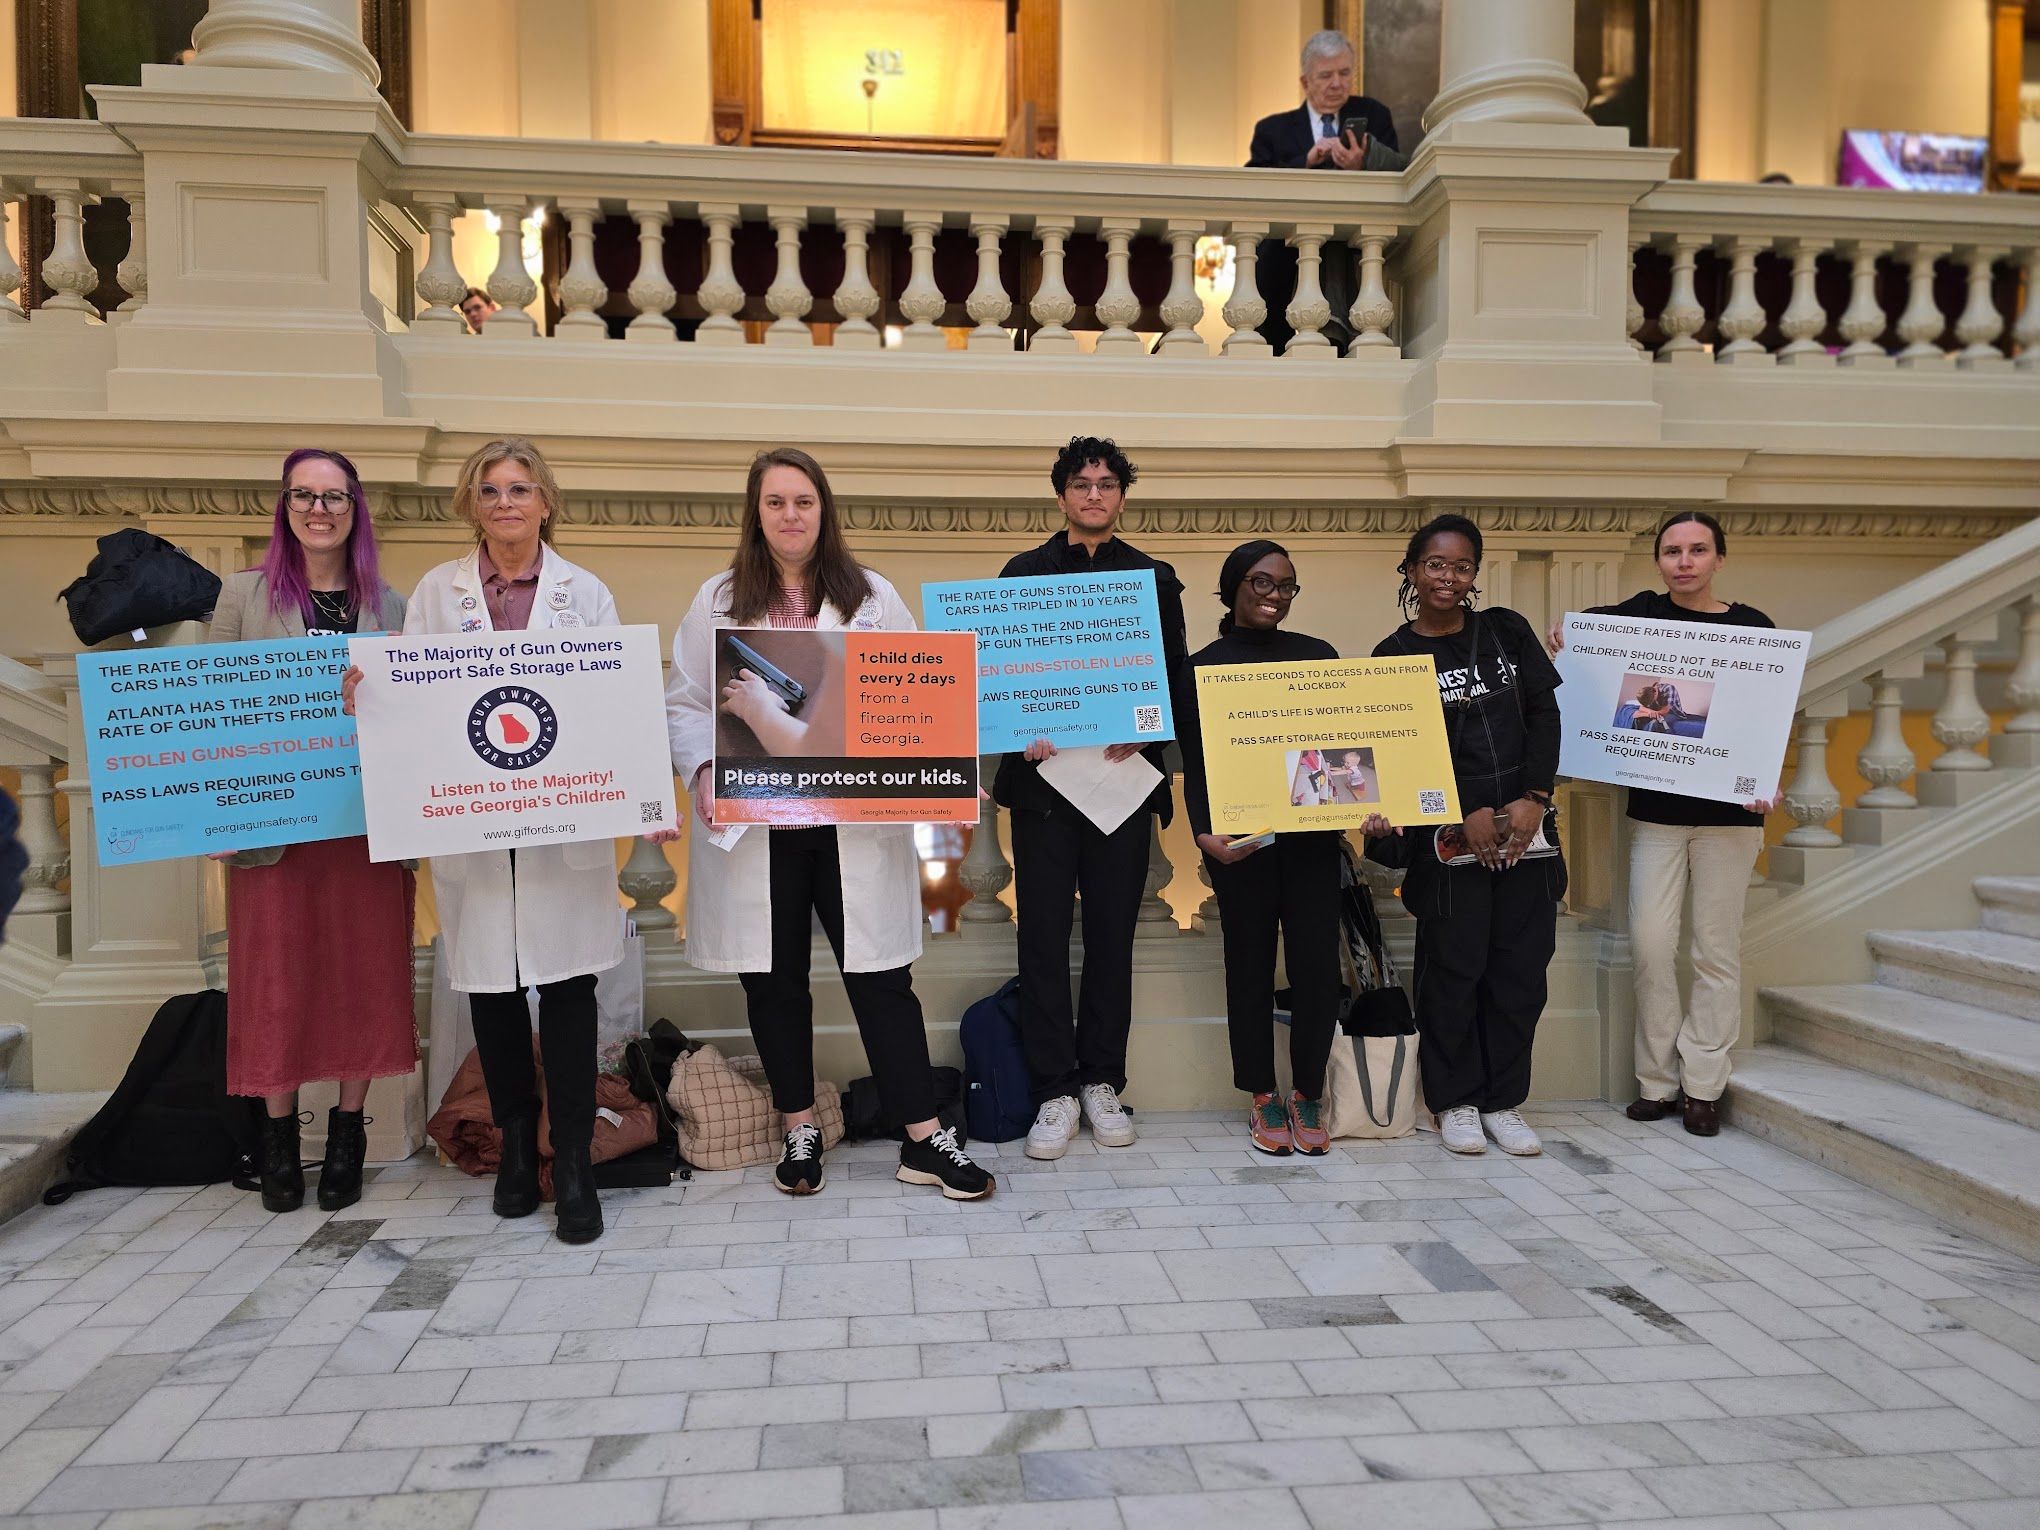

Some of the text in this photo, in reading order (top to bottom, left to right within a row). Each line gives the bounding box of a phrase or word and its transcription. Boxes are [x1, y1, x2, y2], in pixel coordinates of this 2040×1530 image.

[936, 582, 1142, 604] THE RATE OF GUNS STOLEN FROM
[945, 596, 1138, 616] CARS HAS TRIPLED IN 10 YEARS
[1002, 623, 1028, 634] HAS
[1032, 622, 1056, 633] THE
[1060, 620, 1084, 631] 2ND
[1088, 616, 1142, 629] HIGHEST
[994, 638, 1022, 649] GUN
[1025, 635, 1073, 648] THEFTS
[1076, 632, 1112, 644] FROM
[1116, 630, 1150, 641] CARS
[1571, 621, 1802, 650] GUN SUICIDE RATES IN KIDS ARE RISING
[386, 640, 623, 663] The Majority of Gun Owners
[860, 652, 943, 664] 1 child dies
[1572, 644, 1784, 674] CHILDREN SHOULD NOT BE ABLE TO
[99, 648, 350, 678] THE RATE OF GUNS STOLEN FR
[391, 658, 622, 684] Support Safe Storage Laws
[1004, 657, 1110, 675] GUNS=STOLEN
[1114, 654, 1154, 667] LIVES
[1628, 662, 1715, 680] ACCESS A GUN
[111, 664, 346, 693] CARS HAS TRIPLED IN 10 YEA
[860, 673, 956, 687] every 2 days
[1203, 674, 1213, 684] IT
[1214, 673, 1246, 683] TAKES
[1256, 670, 1305, 680] SECONDS
[1306, 670, 1322, 678] TO
[1323, 667, 1362, 678] ACCESS
[1364, 667, 1372, 676] A
[1374, 666, 1397, 676] GUN
[1398, 664, 1428, 674] FROM
[978, 680, 1158, 703] AWS REQUIRING GUNS TO BE
[1288, 680, 1346, 692] A LOCKBOX
[107, 690, 342, 722] ATLANTA HAS THE 2ND HIGH
[472, 690, 552, 726] GUN OWNERS
[860, 692, 909, 704] from a
[1021, 700, 1080, 714] SECURED
[860, 712, 934, 724] firearm in
[1228, 712, 1236, 720] A
[1280, 708, 1302, 718] LIFE
[1304, 707, 1314, 716] IS
[1315, 704, 1354, 716] WORTH
[1355, 706, 1362, 714] 2
[1363, 703, 1413, 714] SECONDS
[99, 724, 144, 739] RATE
[150, 722, 174, 735] OF
[179, 718, 216, 732] GUN
[220, 712, 286, 728] THEFTS
[290, 708, 338, 720] FROM
[1013, 722, 1098, 736] georgiagunsafety.org
[860, 732, 924, 747] Georgia.
[1230, 729, 1418, 746] PASS SAFE STORAGE REQUIREMENTS
[1580, 730, 1730, 758] PASS SAFE GUN STORAGE
[106, 751, 186, 771] STOLEN
[192, 736, 334, 762] GUNS=STOLEN
[476, 736, 552, 766] FOR SAFETY
[1605, 745, 1696, 766] REQUIREMENTS
[102, 765, 362, 803] PASS LAWS REQUIRING GUNS T
[430, 770, 614, 798] Listen to the Majority!
[724, 769, 968, 788] Please protect our kids.
[1615, 769, 1676, 786] georgiamajority.org
[216, 788, 296, 806] SECURED
[422, 788, 626, 818] Save Georgia's Children
[886, 808, 909, 816] Majority
[933, 808, 952, 816] Safety
[204, 814, 318, 837] georgiagunsafety.org
[483, 822, 576, 840] www.giffords.org
